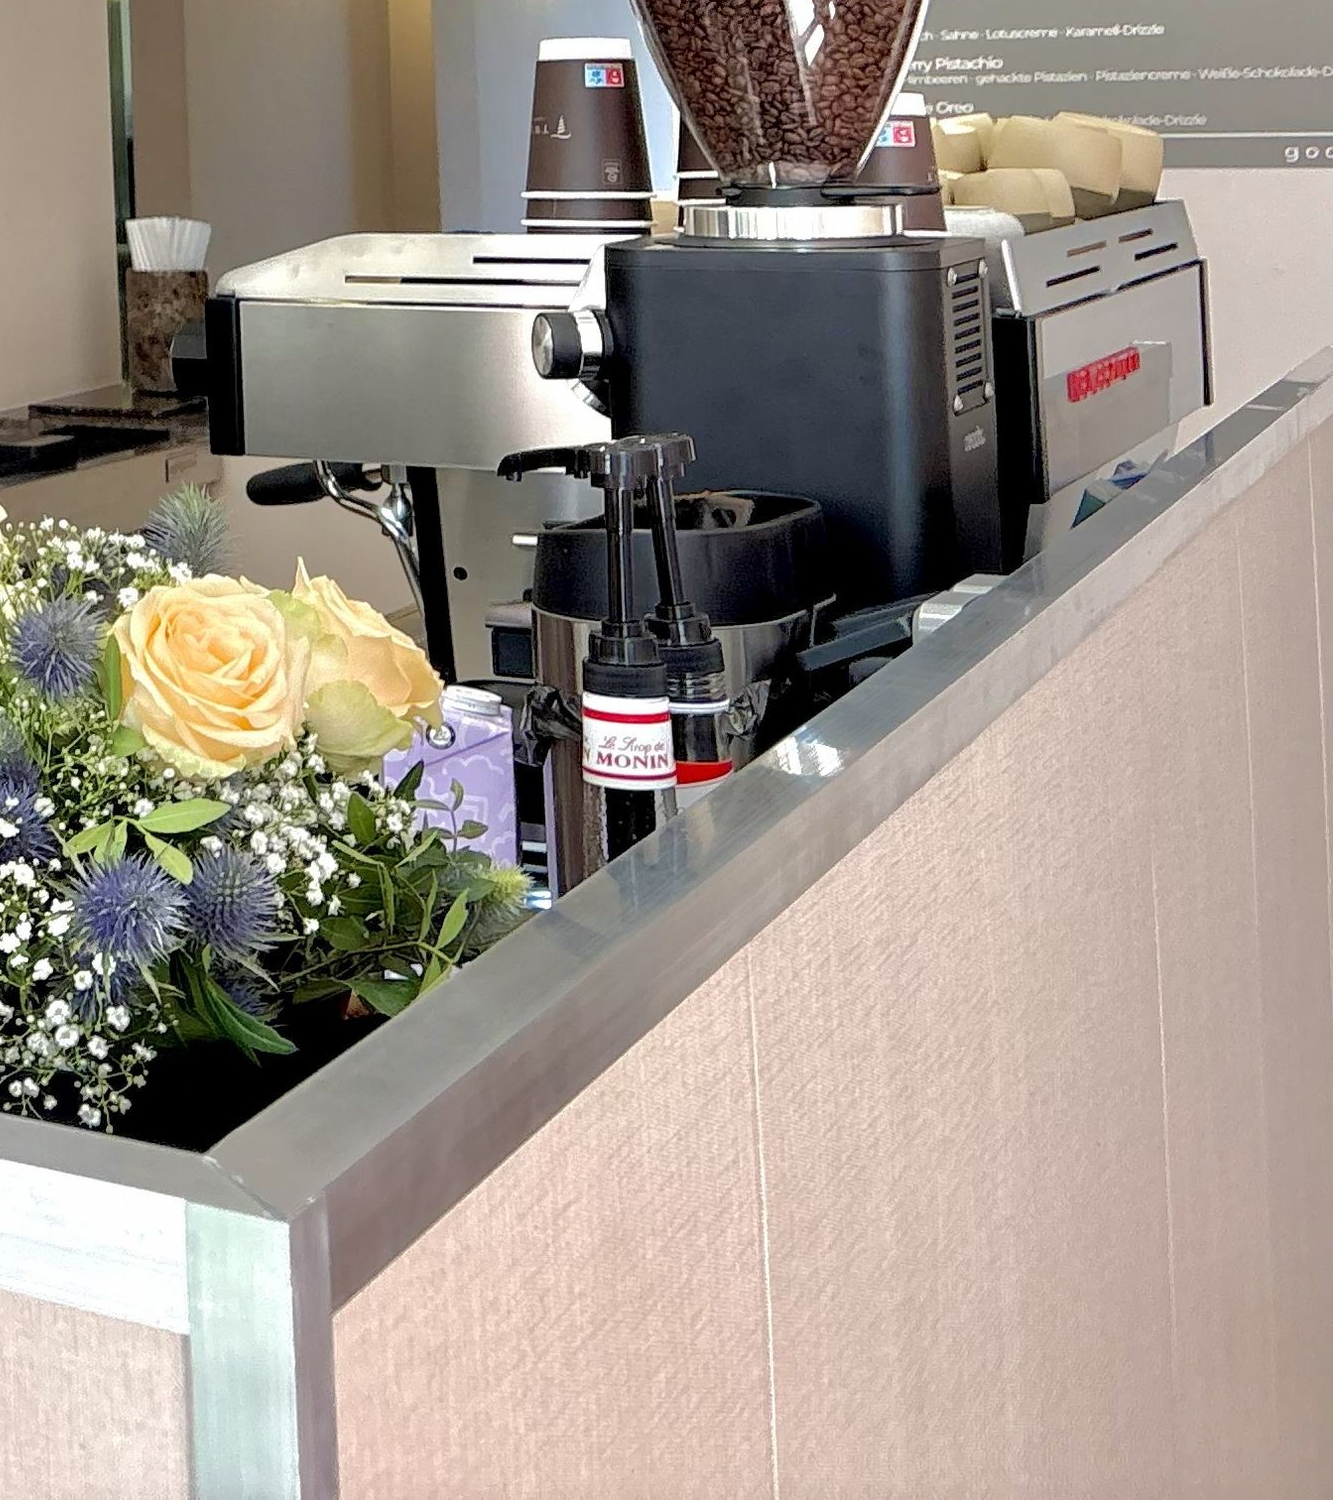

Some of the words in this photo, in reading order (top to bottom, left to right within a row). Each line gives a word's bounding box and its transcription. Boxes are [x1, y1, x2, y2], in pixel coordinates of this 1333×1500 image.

[935, 55, 1004, 71] Pistachio
[906, 73, 969, 86] imbeeren
[936, 101, 974, 114] Oreo
[595, 750, 669, 769] MONIN
